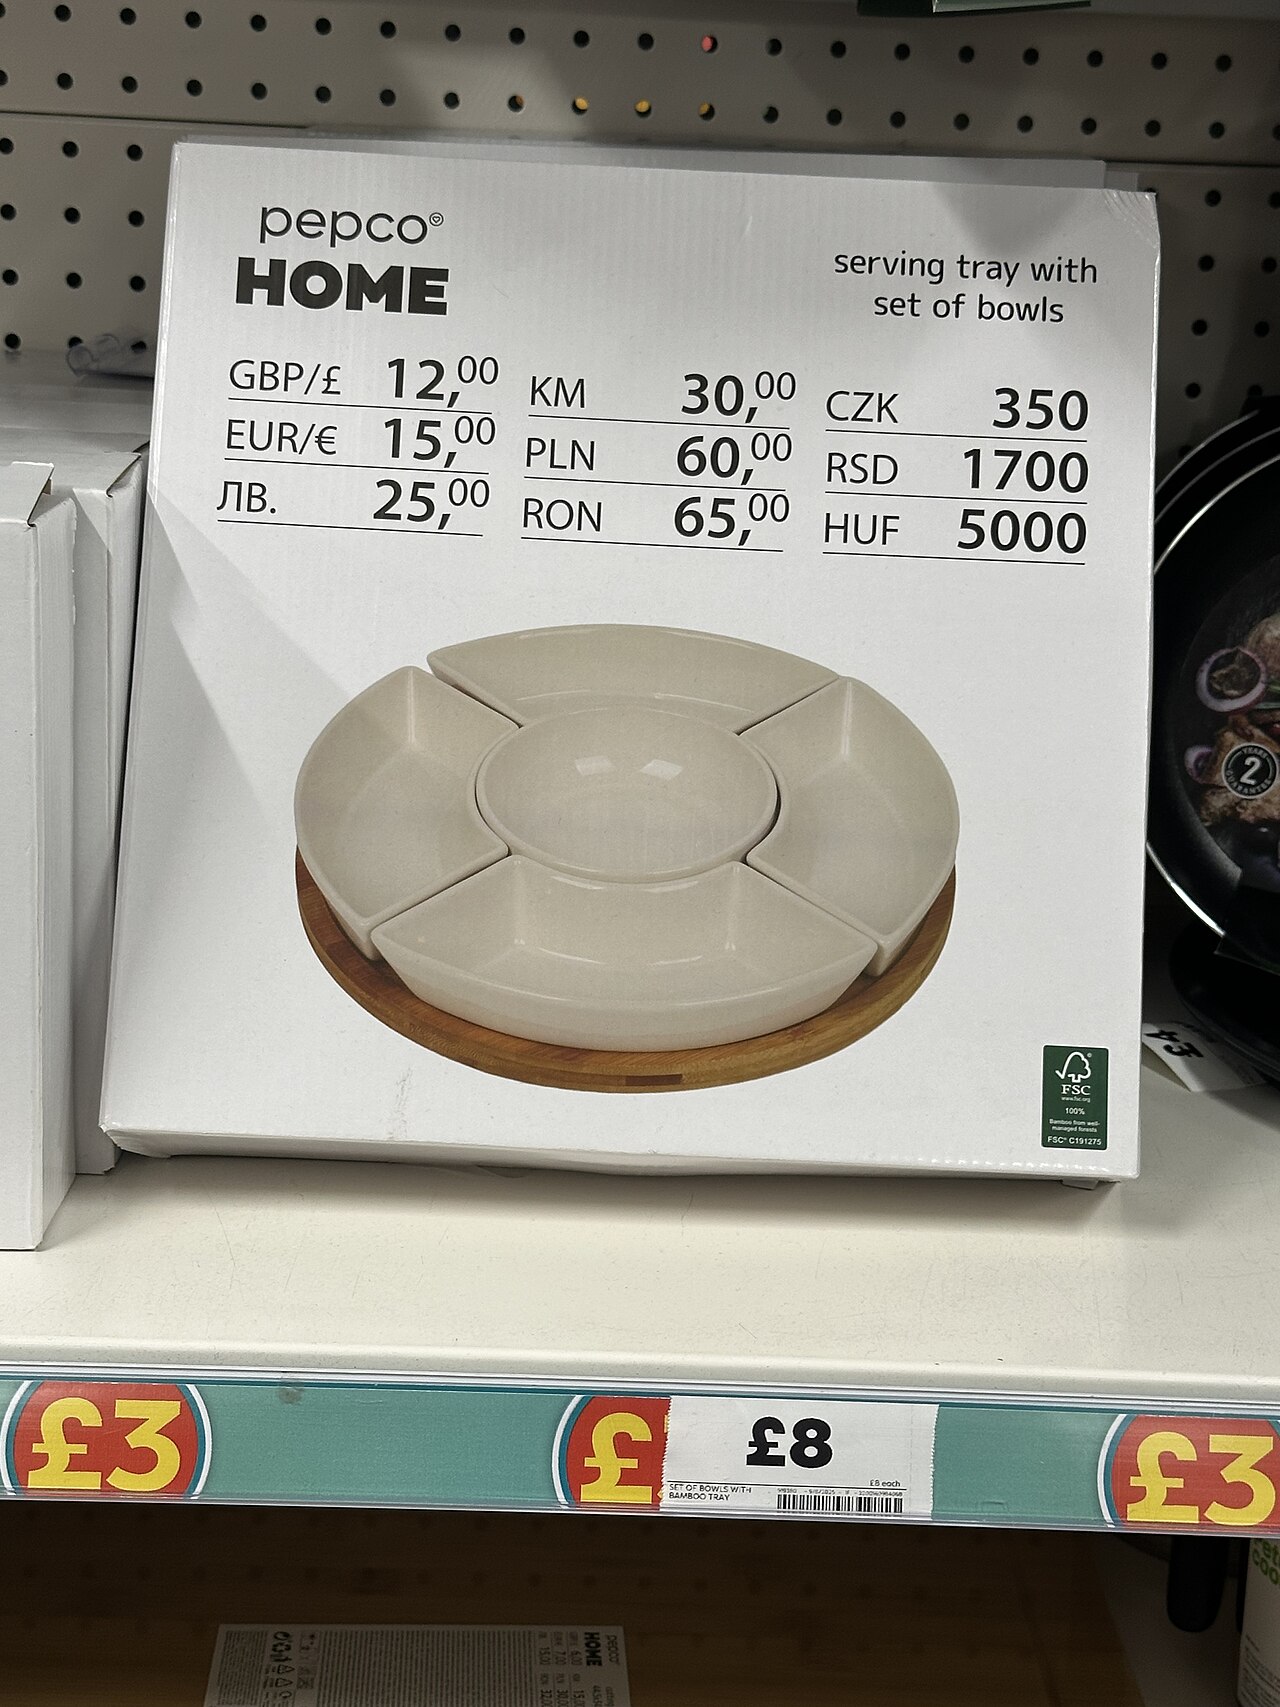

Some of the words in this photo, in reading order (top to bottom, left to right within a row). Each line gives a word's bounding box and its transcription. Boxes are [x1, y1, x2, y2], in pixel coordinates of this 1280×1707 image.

[260, 207, 427, 248] pepco
[236, 257, 449, 315] HOME
[834, 250, 944, 284] serving
[957, 254, 1020, 286] tray
[1030, 257, 1097, 283] with
[874, 294, 920, 317] set
[932, 294, 965, 318] of
[978, 295, 1064, 323] bowls
[229, 359, 342, 396] GBP/£
[531, 376, 586, 409] KM
[826, 391, 899, 423] CZK
[993, 388, 1088, 431] 350
[226, 419, 337, 456] EUR/€
[526, 438, 595, 471] PLN
[827, 452, 898, 484] RSD
[963, 449, 1088, 493] 1700
[523, 499, 602, 532] RON
[824, 513, 899, 545] HUF
[957, 509, 1086, 554] 5000
[1240, 756, 1261, 785] 2
[1061, 1084, 1091, 1095] FSC
[1069, 1137, 1101, 1145] C191275
[27, 1397, 181, 1492] £3
[746, 1416, 833, 1469] £8
[1126, 1431, 1276, 1526] £3
[584, 1632, 603, 1666] HOME
